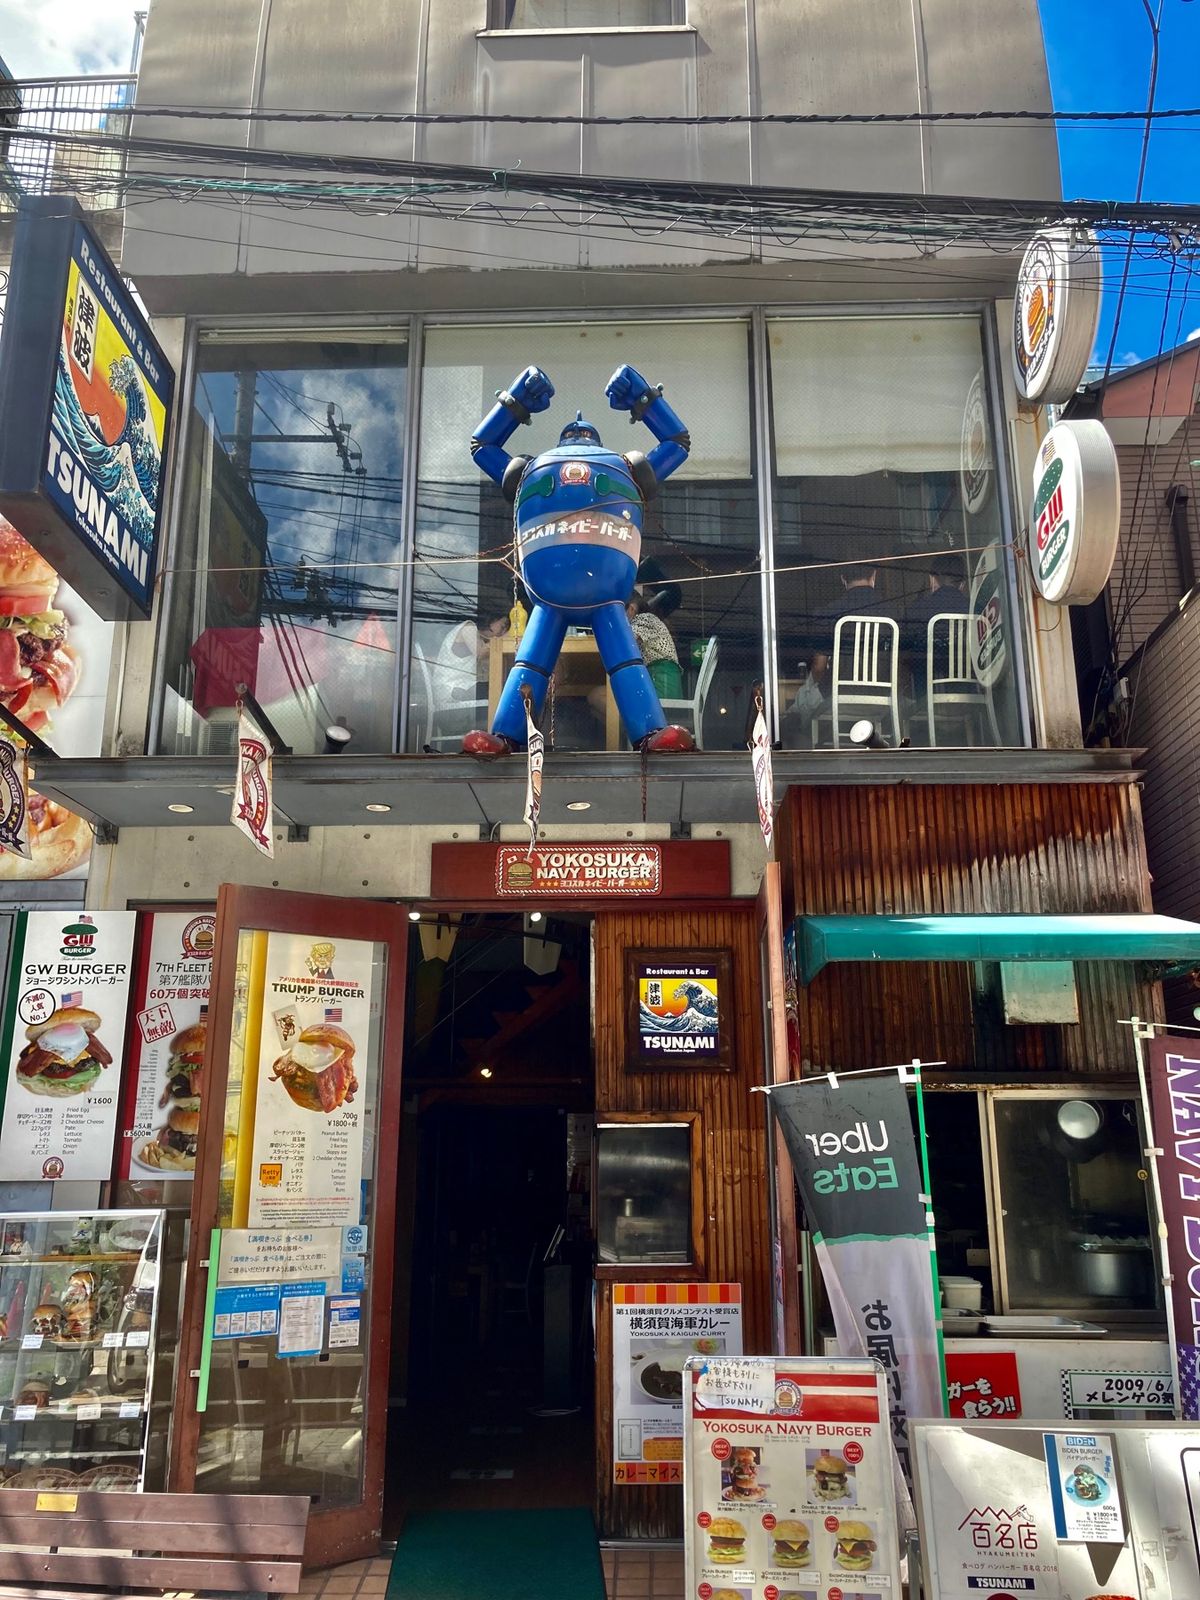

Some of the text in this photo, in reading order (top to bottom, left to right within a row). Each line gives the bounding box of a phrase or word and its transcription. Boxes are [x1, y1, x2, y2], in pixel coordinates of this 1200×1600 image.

[80, 239, 160, 384] Restaurant & Bar
[74, 286, 95, 374] 津波
[47, 430, 149, 588] TSUNAMI
[1042, 526, 1068, 576] BURGER
[536, 853, 650, 867] YOKOSUKA
[536, 867, 651, 879] NAVY BURGER
[560, 879, 628, 888] ヨコスカネイビーバーガー
[25, 963, 127, 975] GW BURGER
[155, 962, 174, 972] 7TH
[176, 962, 206, 973] FLEET
[25, 976, 124, 986] ジョージワシントンバーガー
[272, 983, 365, 999] TRUMP BURGER
[650, 983, 661, 1006] 津波
[295, 995, 343, 1005] トランプバーガー
[30, 1011, 47, 1022] No.1
[643, 1036, 715, 1049] TSUNAMI
[342, 1112, 358, 1120] 700g
[262, 1169, 280, 1178] Retty
[629, 1317, 731, 1330] 横須賀海軍カレー
[716, 1394, 764, 1409] TSUNAMI
[702, 1421, 872, 1437] YOKOSUKA NAVY BURGER
[1066, 1437, 1095, 1446] BIDEN
[615, 1467, 683, 1480] カレーマイス
[970, 1522, 1037, 1550] 百名店
[962, 1562, 985, 1570] 食べログ
[988, 1563, 1021, 1571] ハンバーガー
[1042, 1564, 1058, 1572] 2018
[976, 1578, 1026, 1589] TSUNAMI
